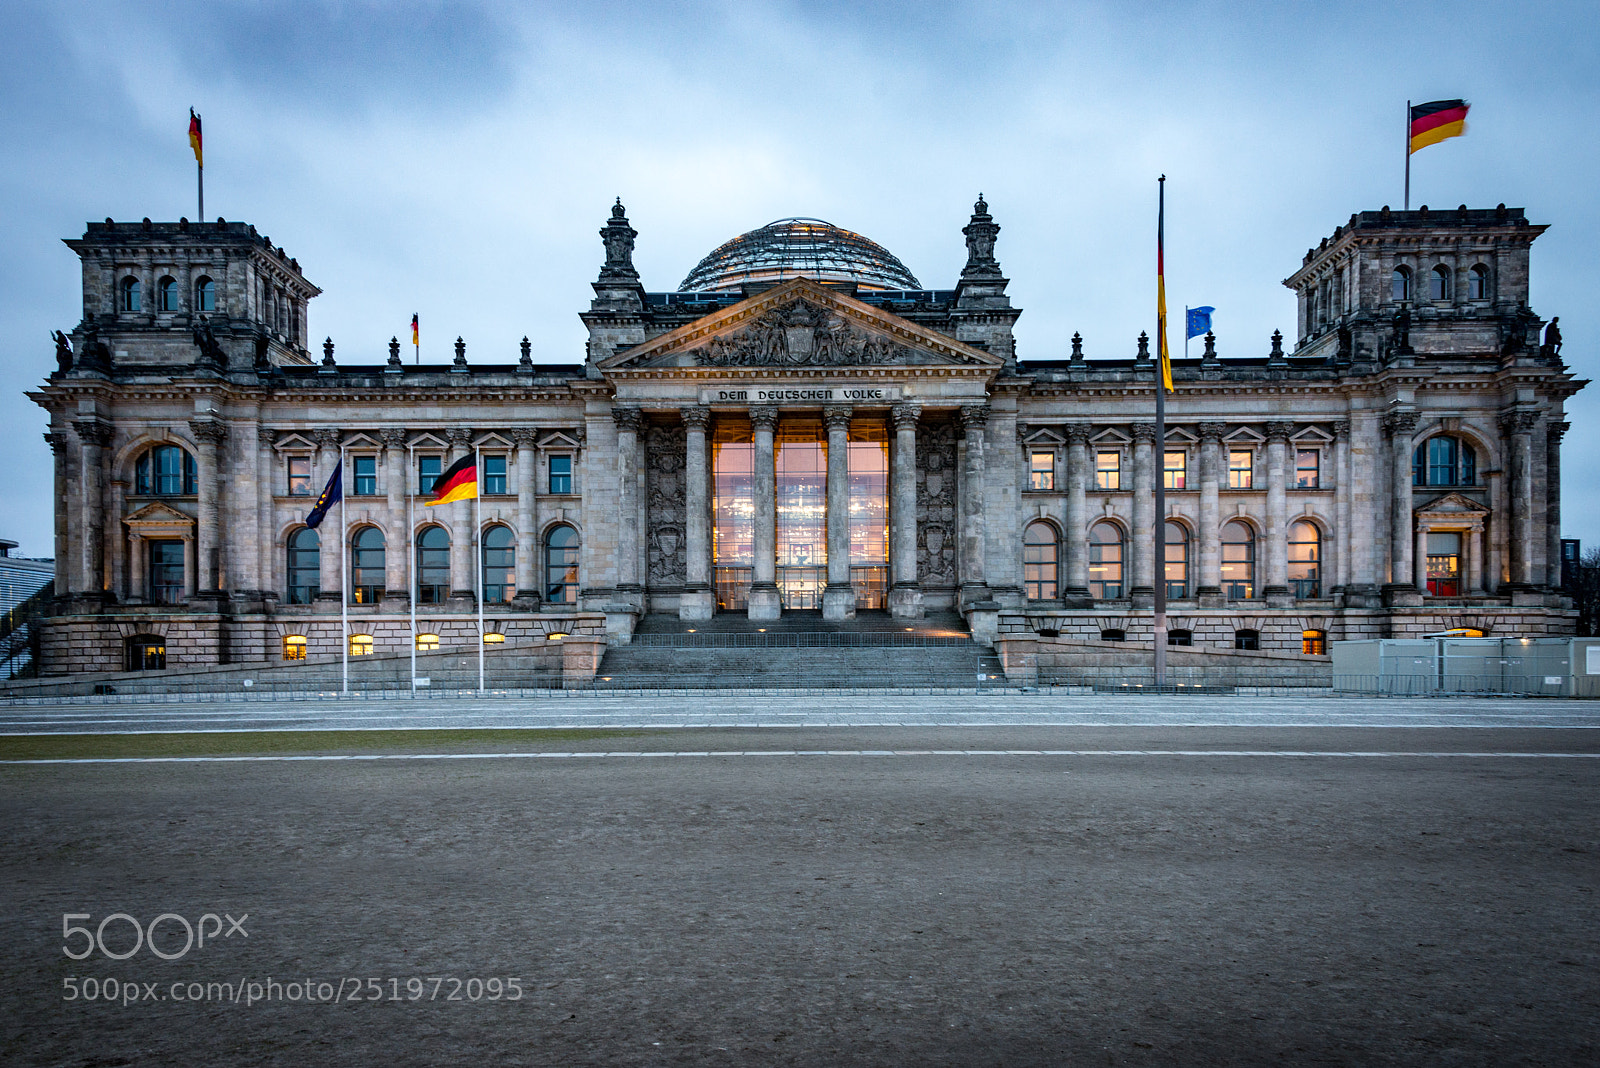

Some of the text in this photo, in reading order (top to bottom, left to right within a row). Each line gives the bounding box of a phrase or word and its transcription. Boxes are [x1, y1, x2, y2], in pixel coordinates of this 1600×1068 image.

[718, 389, 882, 400] DEM DEUTSCHEN VOLKE
